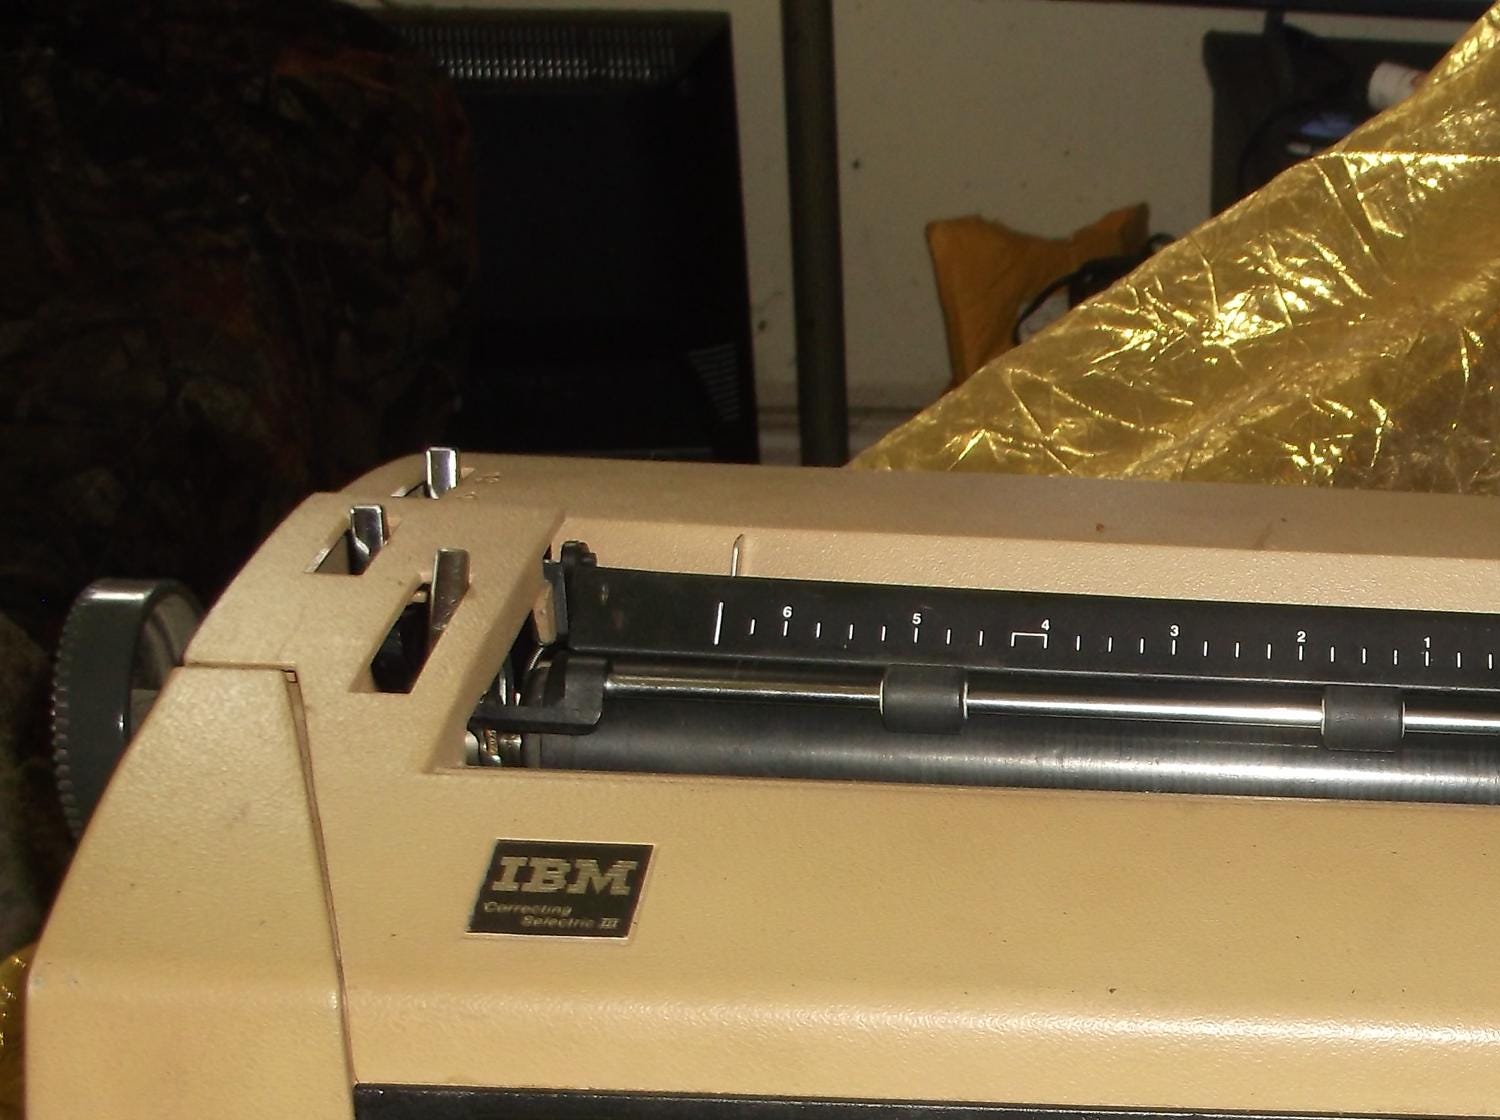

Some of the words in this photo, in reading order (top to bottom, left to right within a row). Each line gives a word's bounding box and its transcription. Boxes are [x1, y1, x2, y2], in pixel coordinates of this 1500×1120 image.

[783, 606, 792, 617] 6
[913, 613, 921, 624] 5
[1041, 620, 1049, 630] 4
[1170, 625, 1178, 636] 3
[1297, 631, 1305, 642] 2
[1424, 637, 1430, 648] 1
[492, 857, 637, 895] IBM
[484, 902, 572, 917] Correcting
